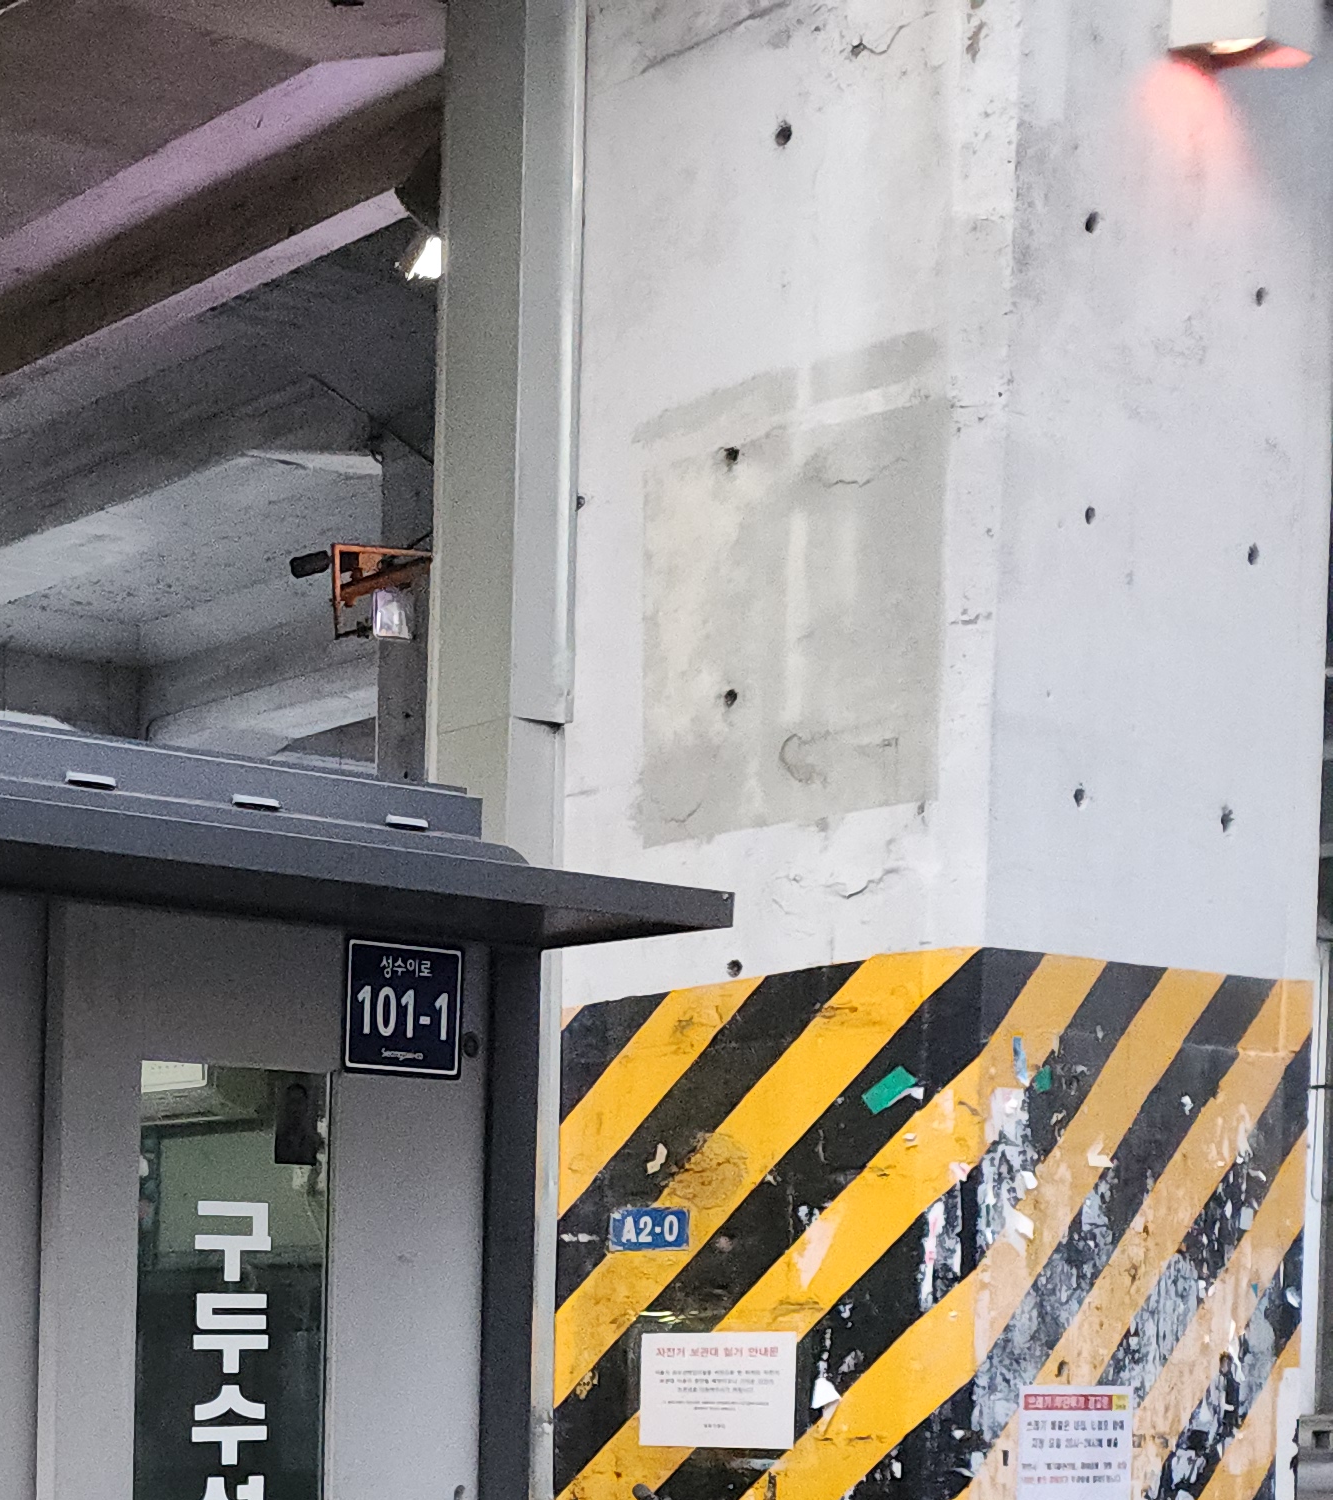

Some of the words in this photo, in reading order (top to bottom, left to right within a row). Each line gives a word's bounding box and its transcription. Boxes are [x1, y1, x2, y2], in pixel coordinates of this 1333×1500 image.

[380, 955, 433, 978] 성수이로
[357, 985, 449, 1041] 101-1
[621, 1214, 679, 1243] A2-0
[656, 1346, 686, 1358] 자전거
[747, 1346, 779, 1358] 안내문
